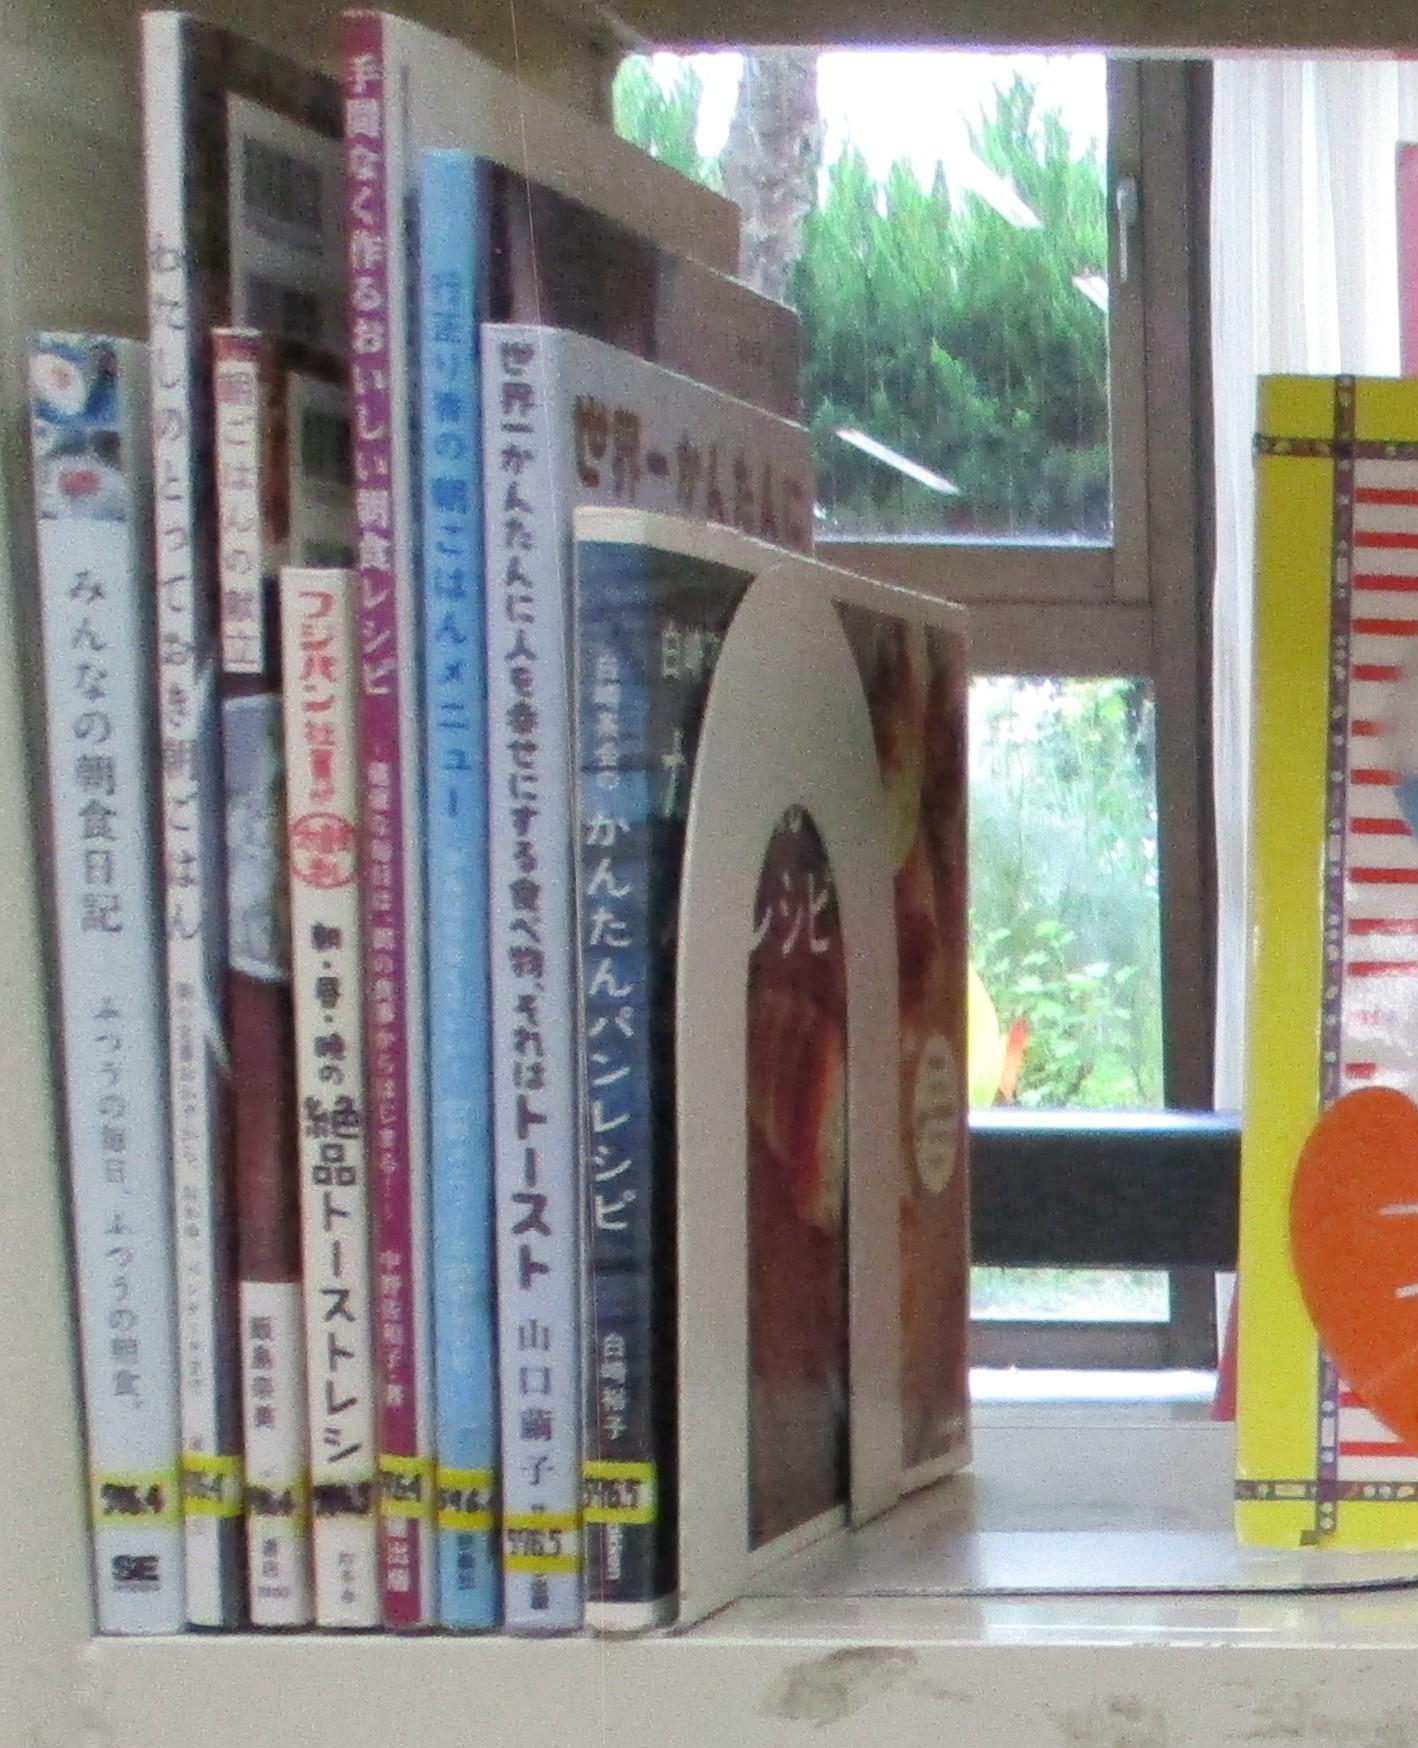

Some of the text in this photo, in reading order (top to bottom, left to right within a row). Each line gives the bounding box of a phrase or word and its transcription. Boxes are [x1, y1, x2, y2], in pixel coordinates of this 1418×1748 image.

[69, 567, 123, 934] みんなの朝食日記
